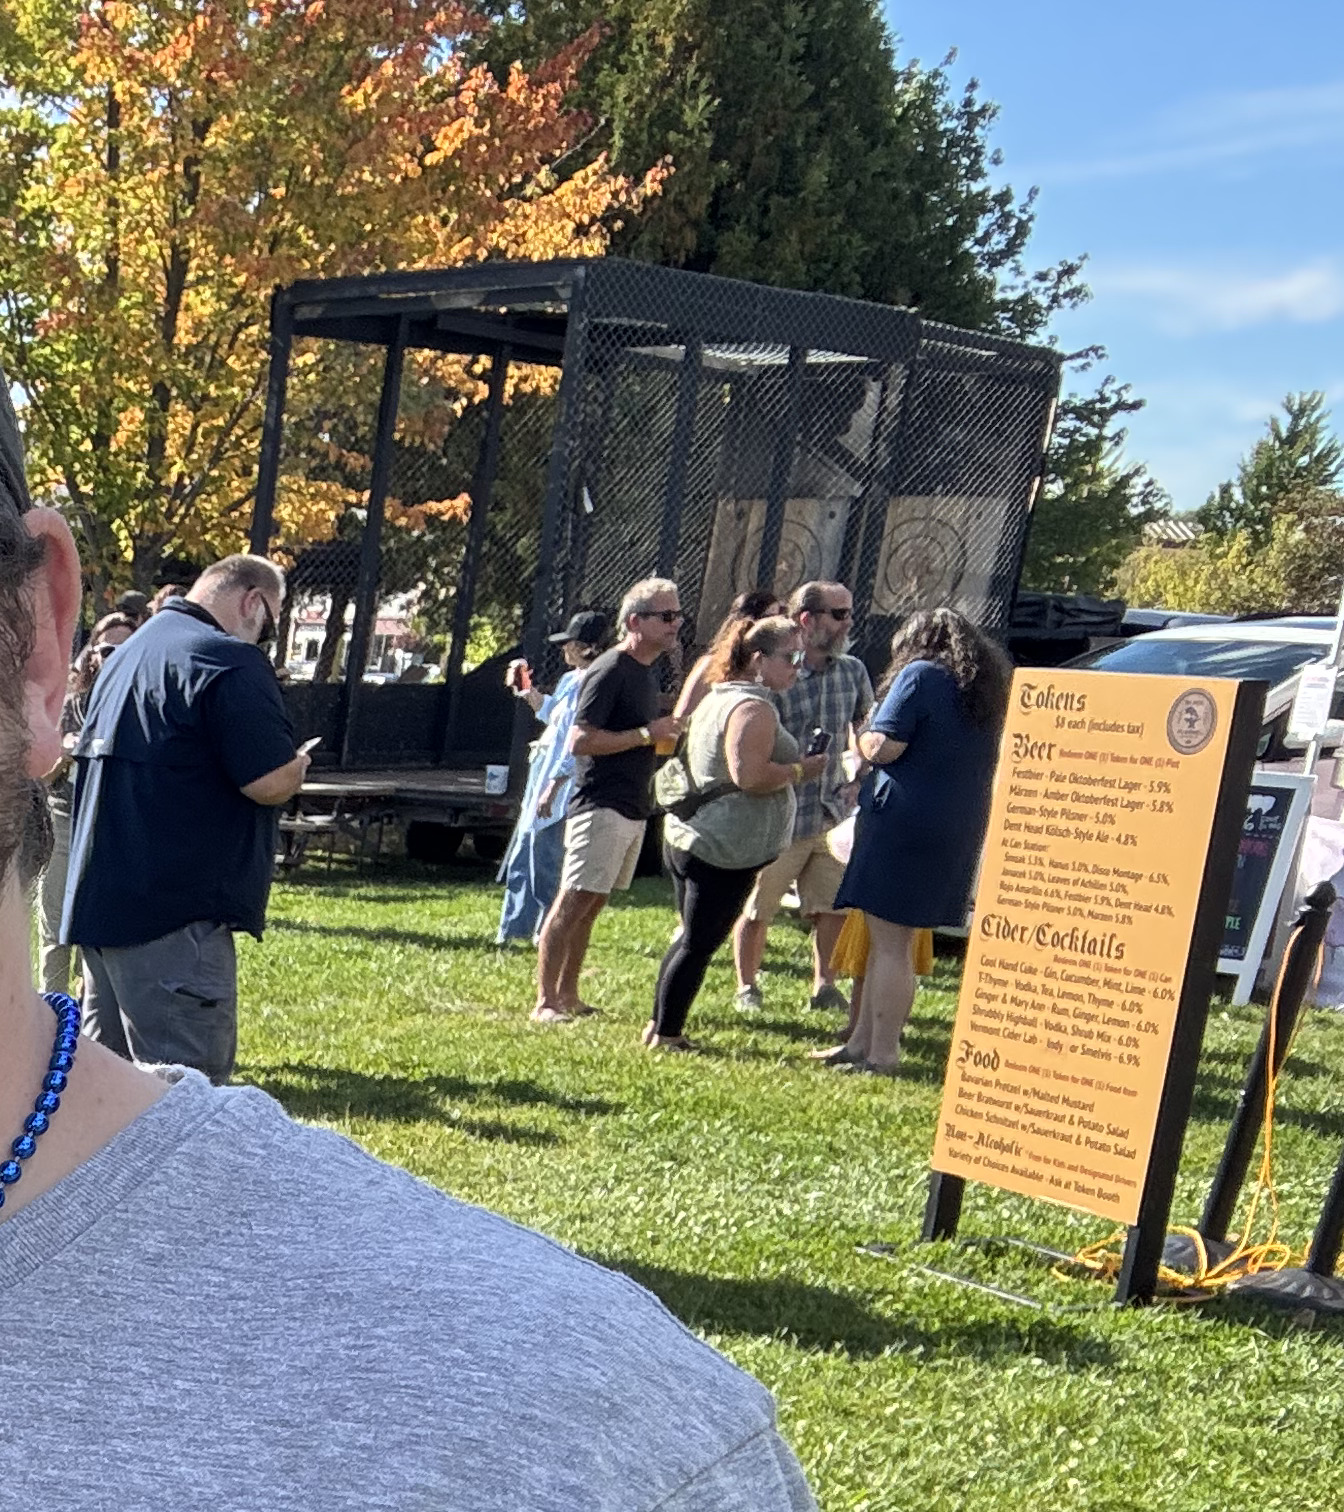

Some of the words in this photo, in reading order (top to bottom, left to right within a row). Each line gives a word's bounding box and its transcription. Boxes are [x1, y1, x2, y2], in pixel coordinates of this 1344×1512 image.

[1021, 683, 1087, 715] Tokens
[1067, 718, 1087, 730] each
[1087, 719, 1125, 733] (includes
[1012, 733, 1057, 764] Beer
[1068, 772, 1117, 789] Oktoberfest
[1118, 778, 1143, 794] Lager
[1148, 780, 1171, 794] 5.9%
[1043, 788, 1070, 802] Amber
[1071, 791, 1119, 808] Oktoberfest
[1120, 797, 1145, 813] Lager
[1151, 799, 1174, 814] 5.8%
[1095, 830, 1110, 844] Ale
[1116, 833, 1138, 847] 4.8%
[981, 914, 1126, 960] Cider/Cocktails
[998, 959, 1019, 973] Hand
[1152, 987, 1176, 1002] 6.0%
[1010, 995, 1030, 1012] Mary
[1029, 999, 1046, 1012] Ann
[1102, 1013, 1130, 1029] Lemon
[1136, 1020, 1159, 1036] 6.0%
[1121, 1000, 1143, 1015] 6.0%
[1117, 1035, 1140, 1049] 6.0%
[956, 1040, 1000, 1072] Food
[1118, 1052, 1141, 1068] 6.9%
[1077, 1116, 1105, 1134] Potato
[1106, 1123, 1130, 1140] Salad
[1085, 1136, 1112, 1153] Potato
[1113, 1143, 1137, 1160] Salad
